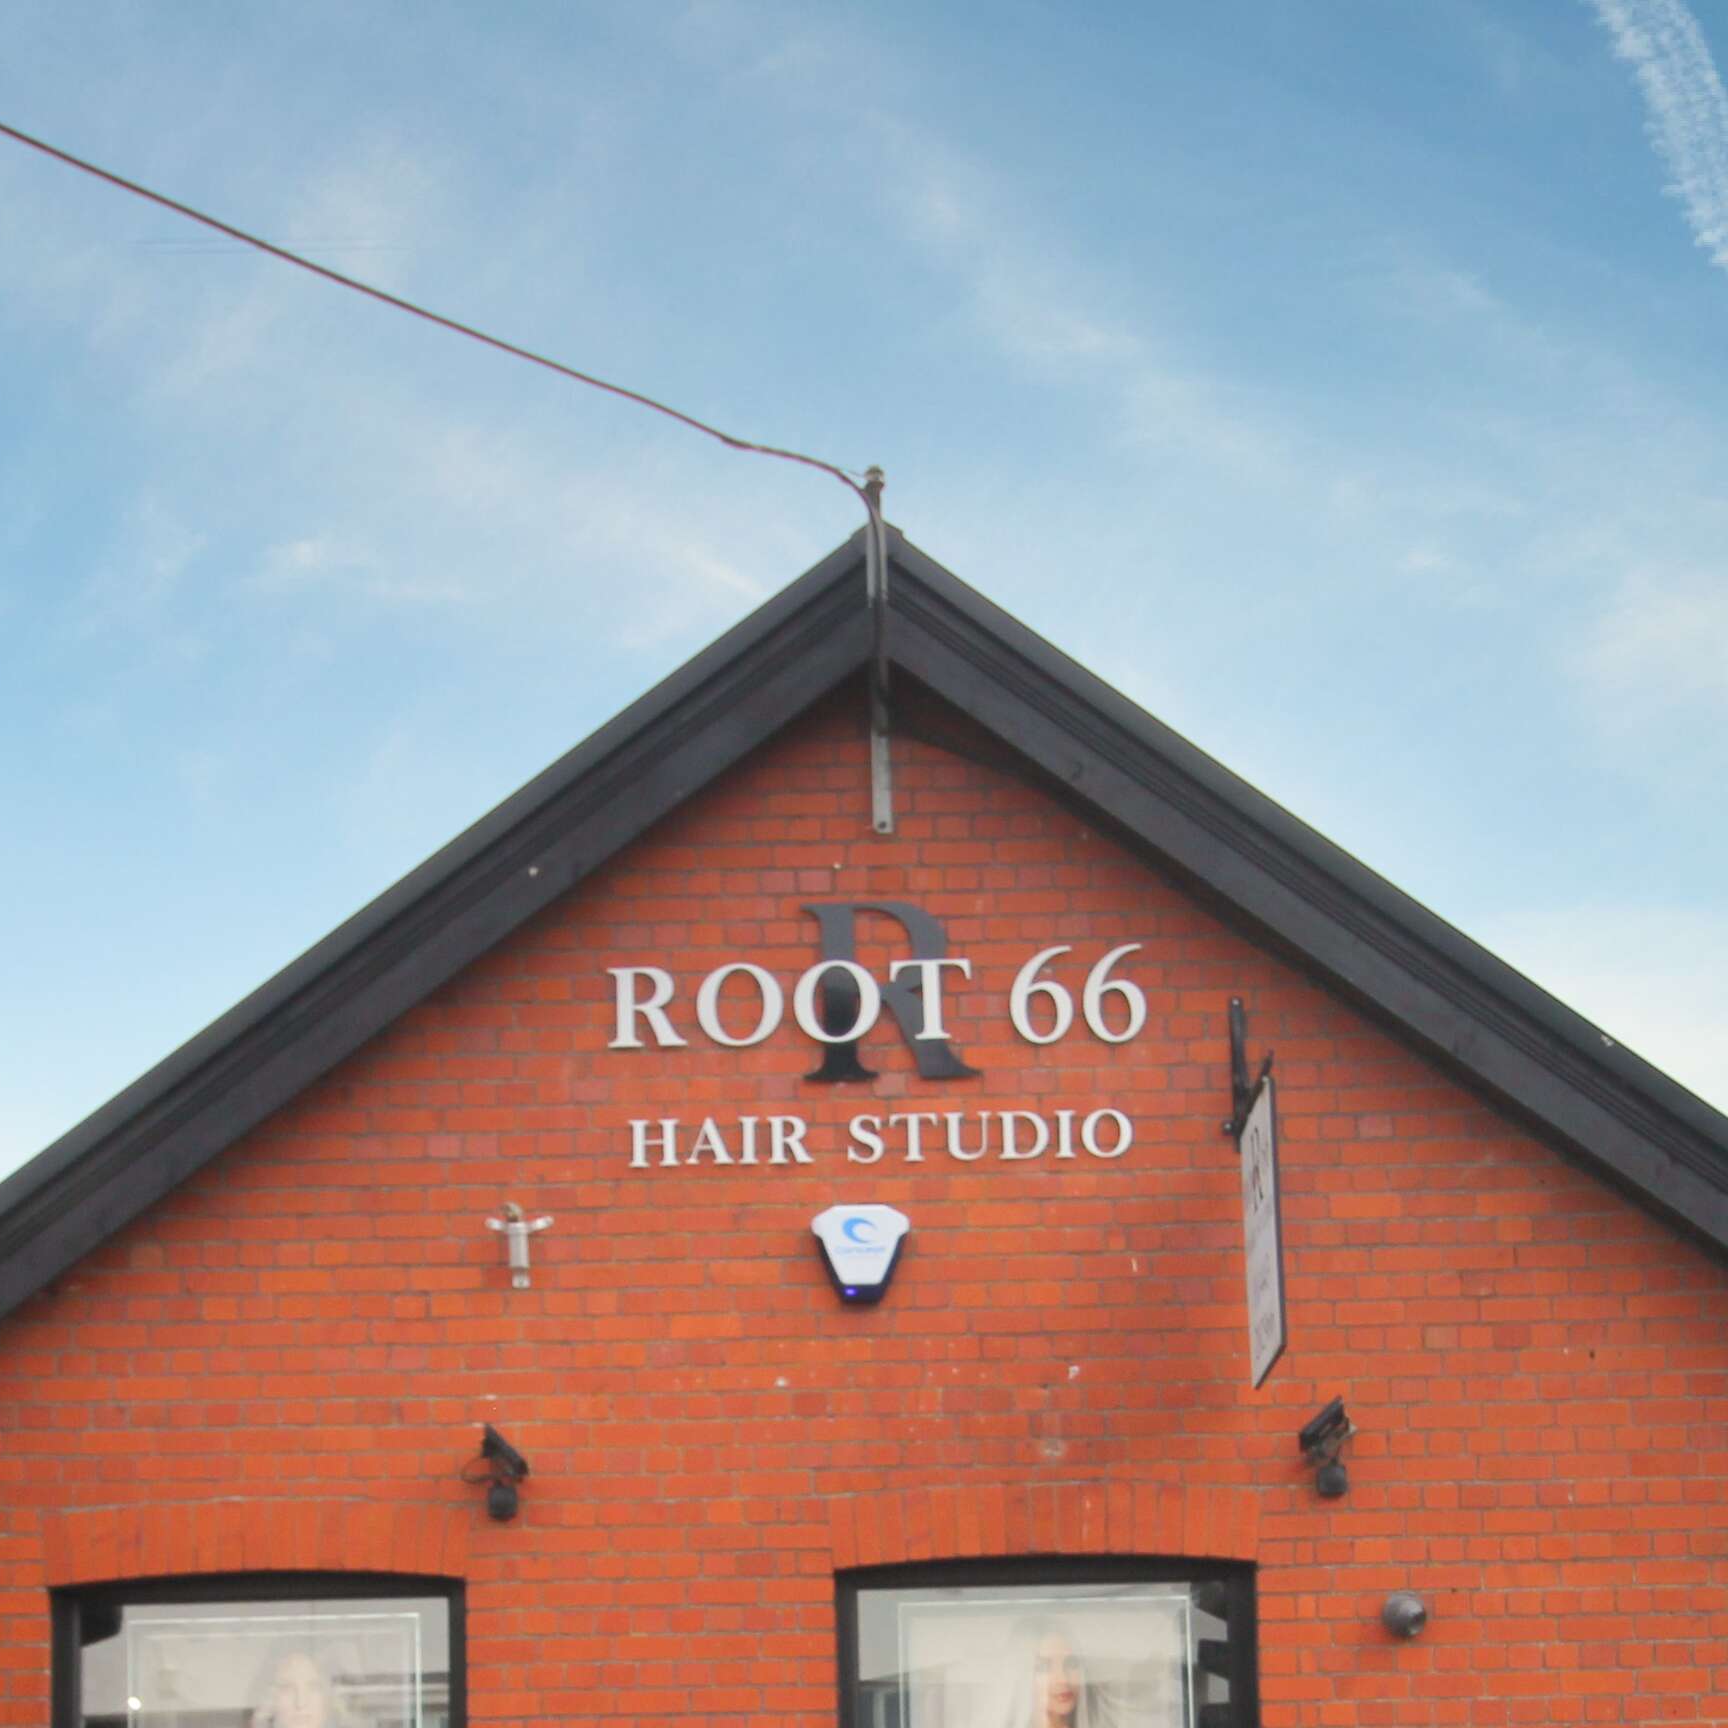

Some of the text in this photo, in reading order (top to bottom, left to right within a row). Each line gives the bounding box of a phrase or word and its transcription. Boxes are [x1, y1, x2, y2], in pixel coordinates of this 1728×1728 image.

[606, 943, 1147, 1048] ROOT 66
[628, 1108, 1134, 1168] HAIR STUDIO
